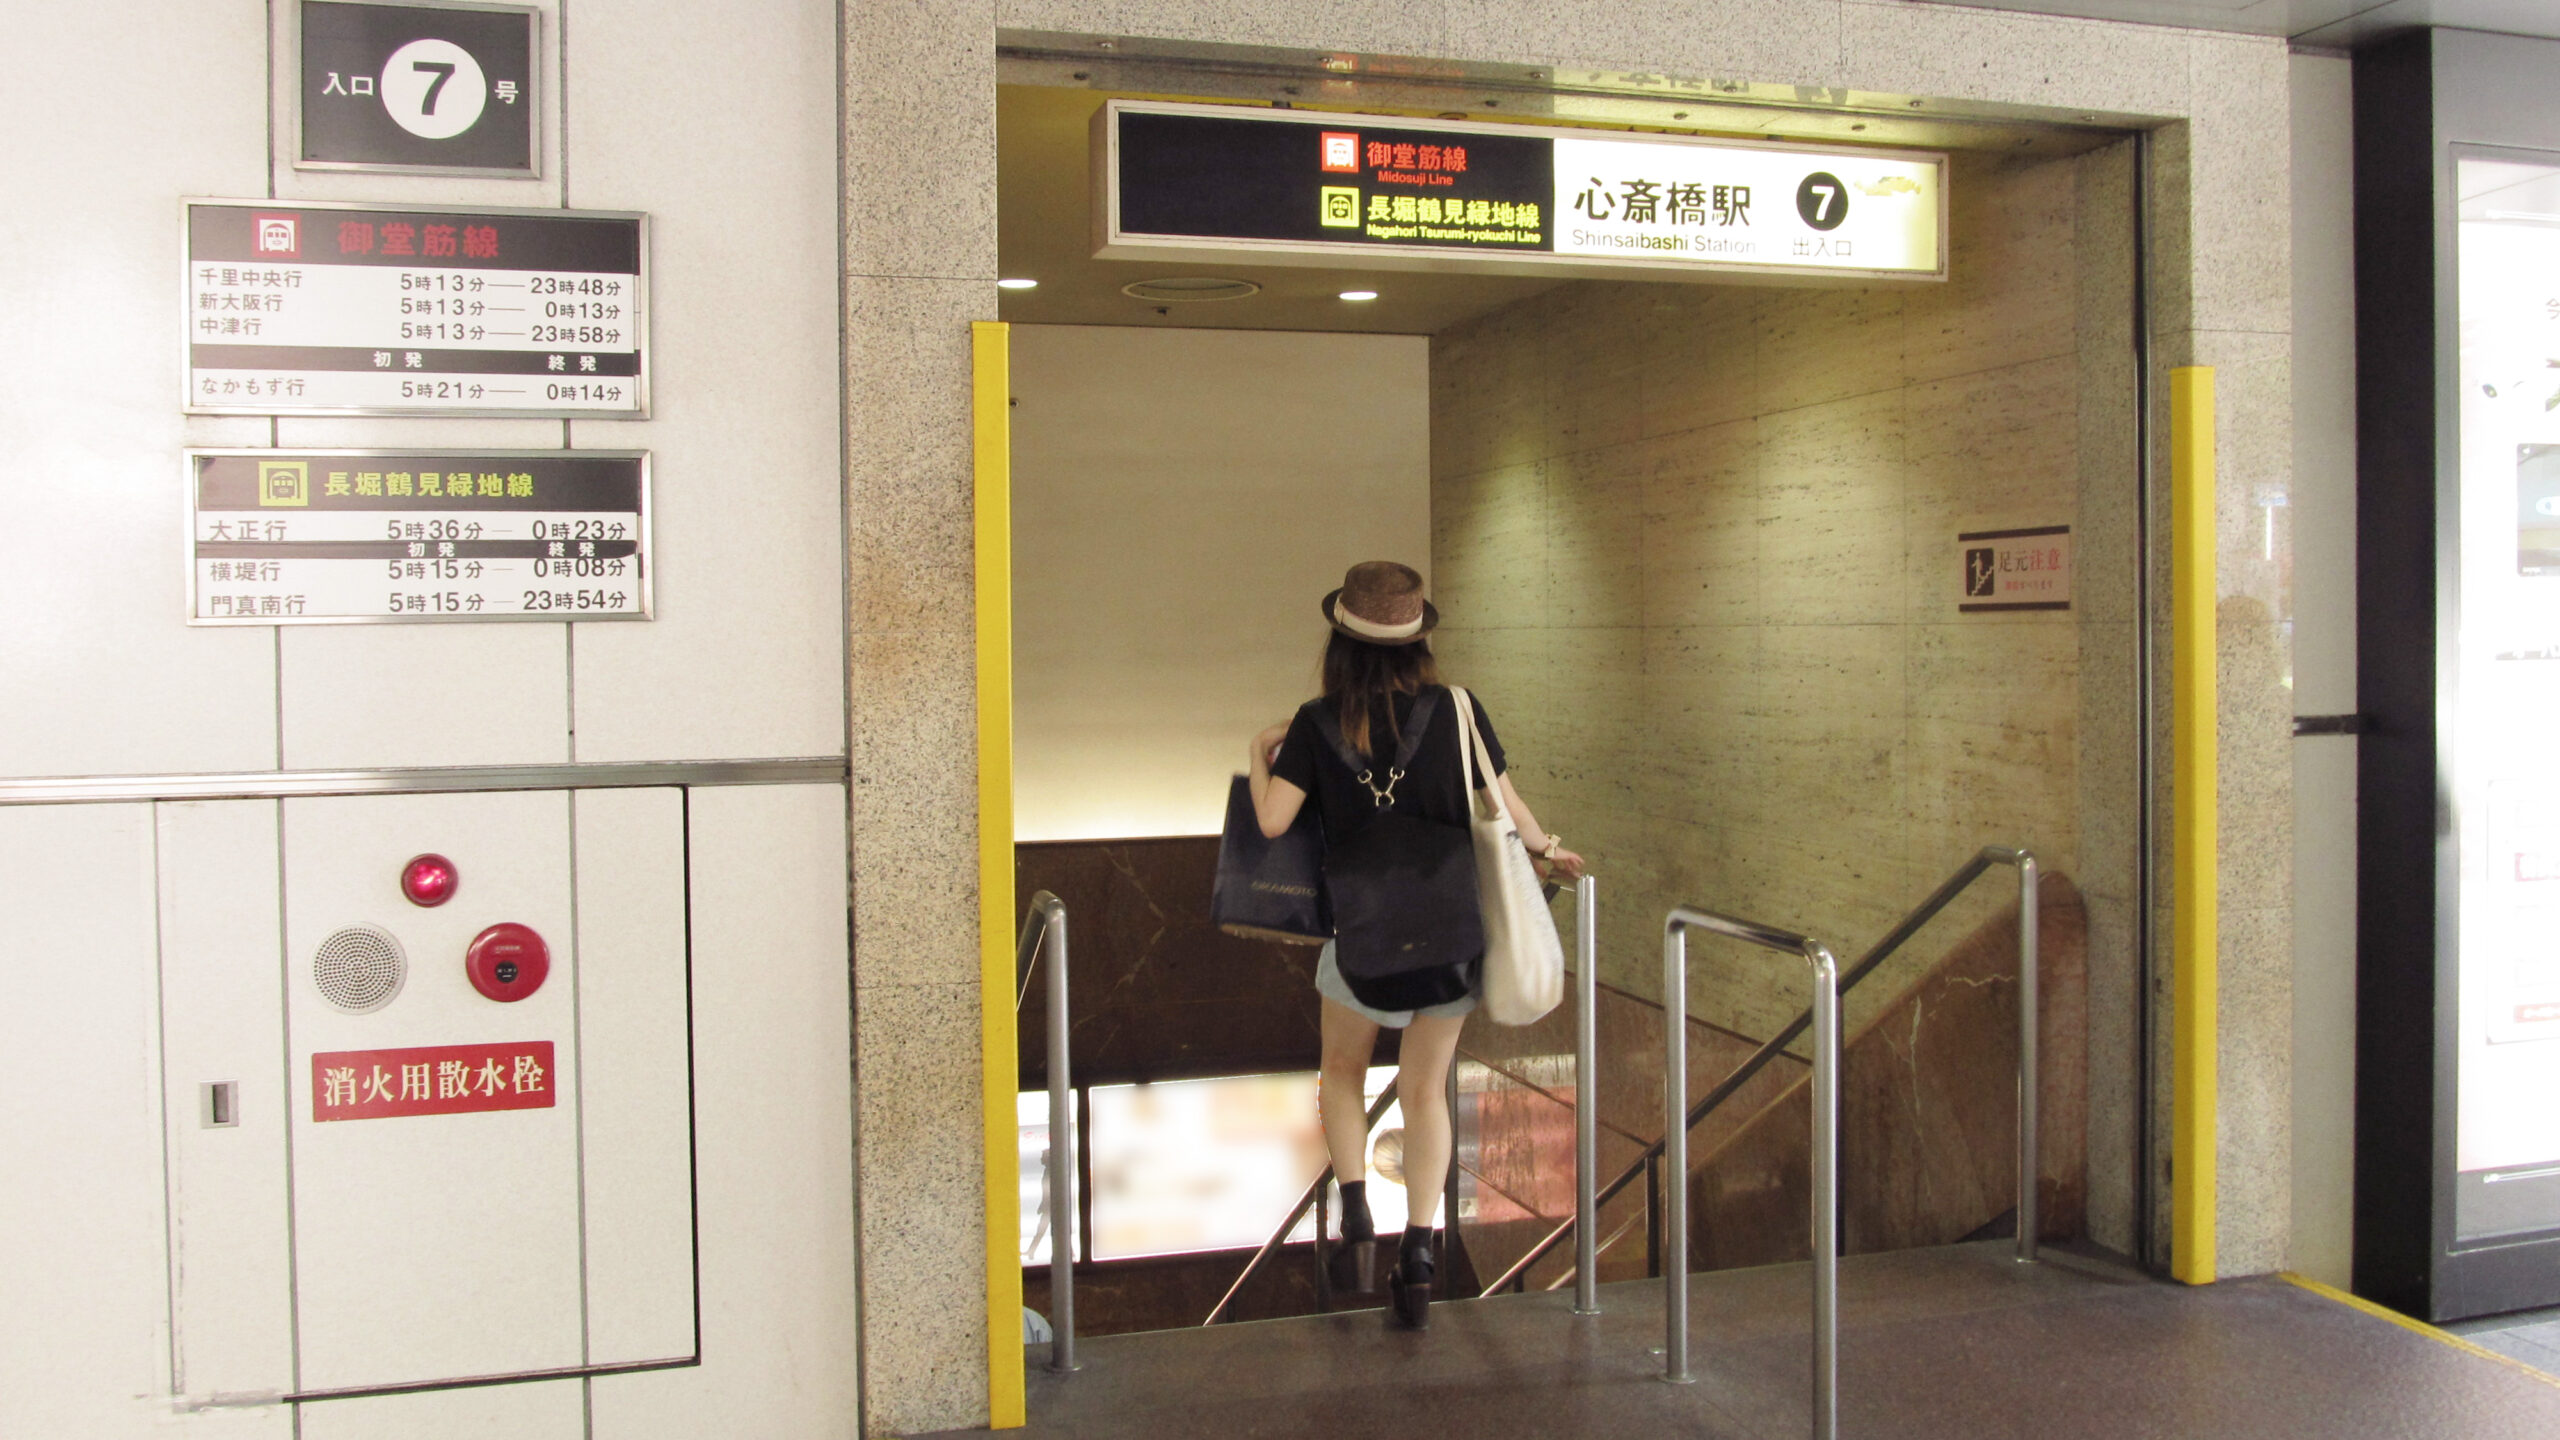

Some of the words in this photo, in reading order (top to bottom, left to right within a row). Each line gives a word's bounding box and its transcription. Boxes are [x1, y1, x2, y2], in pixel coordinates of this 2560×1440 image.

[322, 72, 374, 96] 入口
[412, 61, 456, 116] 7
[494, 80, 519, 104] 号
[1367, 141, 1467, 172] 御堂筋線
[1378, 171, 1426, 186] Midosuji
[1429, 174, 1454, 186] Line
[1367, 195, 1541, 229] 長堀鶴見緑地線
[1574, 176, 1751, 227] 心斎橋駅
[1810, 185, 1836, 222] 7
[337, 221, 499, 258] 御堂筋線
[1366, 224, 1418, 239] Nagahori
[1420, 226, 1515, 243] Tsurumi-ryokuchi
[1517, 230, 1542, 243] Line
[1573, 229, 1689, 251] Shinsaibashi
[1694, 234, 1757, 255] Station
[1792, 237, 1852, 257] 出入口
[199, 268, 303, 288] 千里中央行
[400, 273, 485, 292] 5時13分
[531, 277, 621, 296] 23時48分
[199, 292, 283, 312] 新大阪行
[400, 297, 486, 316] 5時13分
[545, 301, 621, 320] 0時13分
[199, 317, 263, 335] 中津行
[400, 322, 486, 341] 5時13分
[531, 325, 621, 344] 23時58分
[201, 376, 305, 396] なかもず行
[401, 381, 485, 400] 5時21分
[546, 384, 622, 402] 0時14分
[324, 471, 534, 498] 長堀鶴見緑地線
[209, 519, 287, 541] 大正行
[387, 519, 484, 540] 5時36分
[532, 520, 626, 540] 0時23分
[209, 561, 281, 582] 横堤行
[388, 559, 484, 580] 5時15分
[210, 594, 307, 616] 門真南行
[388, 591, 485, 613] 5時15分
[522, 589, 628, 611] 23時54分
[323, 1055, 545, 1107] 消火用散水栓
